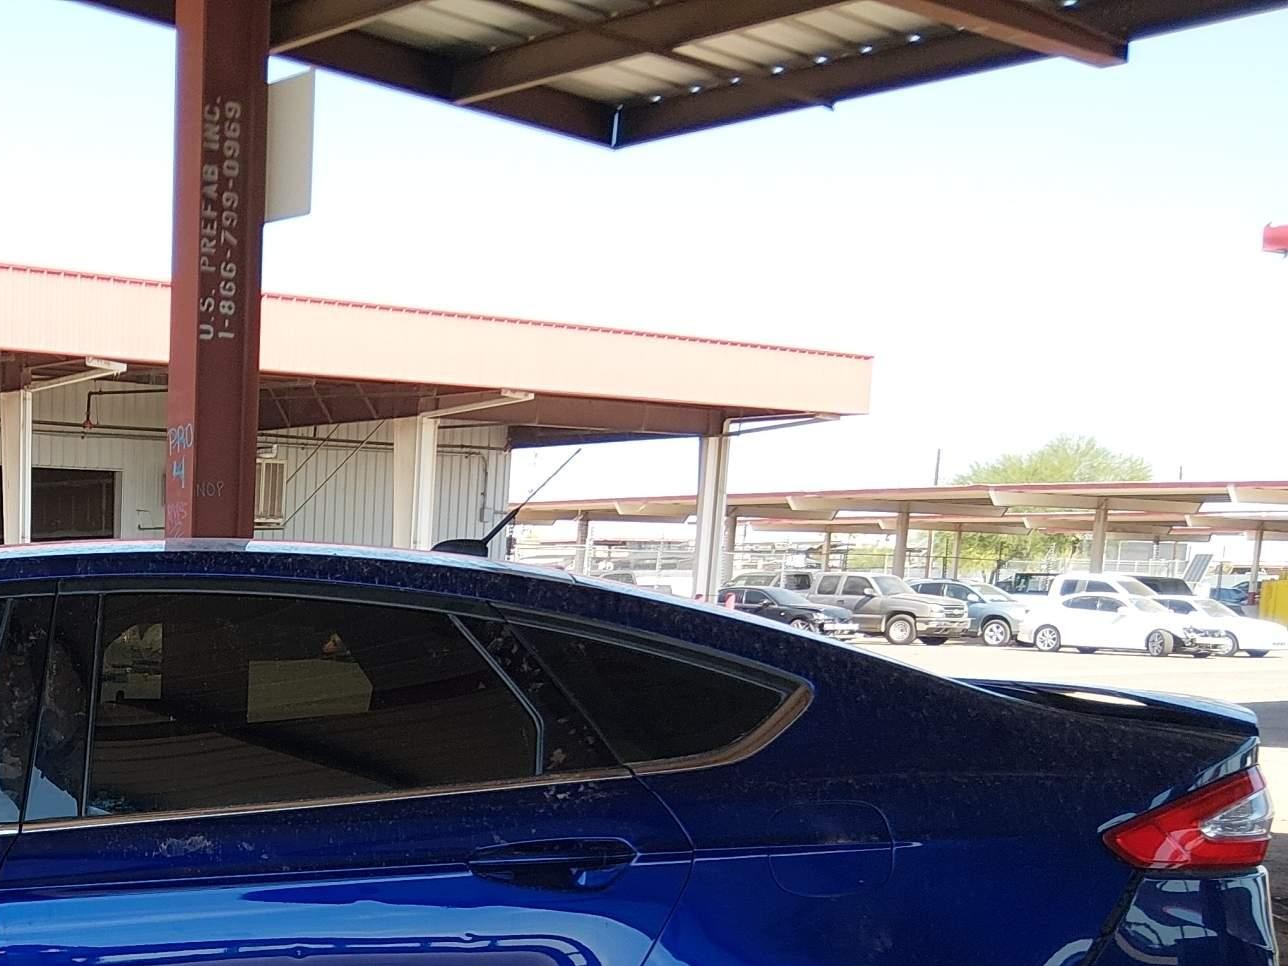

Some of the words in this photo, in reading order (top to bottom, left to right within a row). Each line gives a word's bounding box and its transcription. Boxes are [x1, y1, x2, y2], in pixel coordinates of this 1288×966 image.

[203, 96, 222, 151] INC.
[200, 164, 219, 272] PREFAB
[218, 101, 241, 338] 1-866-799-0969
[199, 289, 216, 340] U.S.
